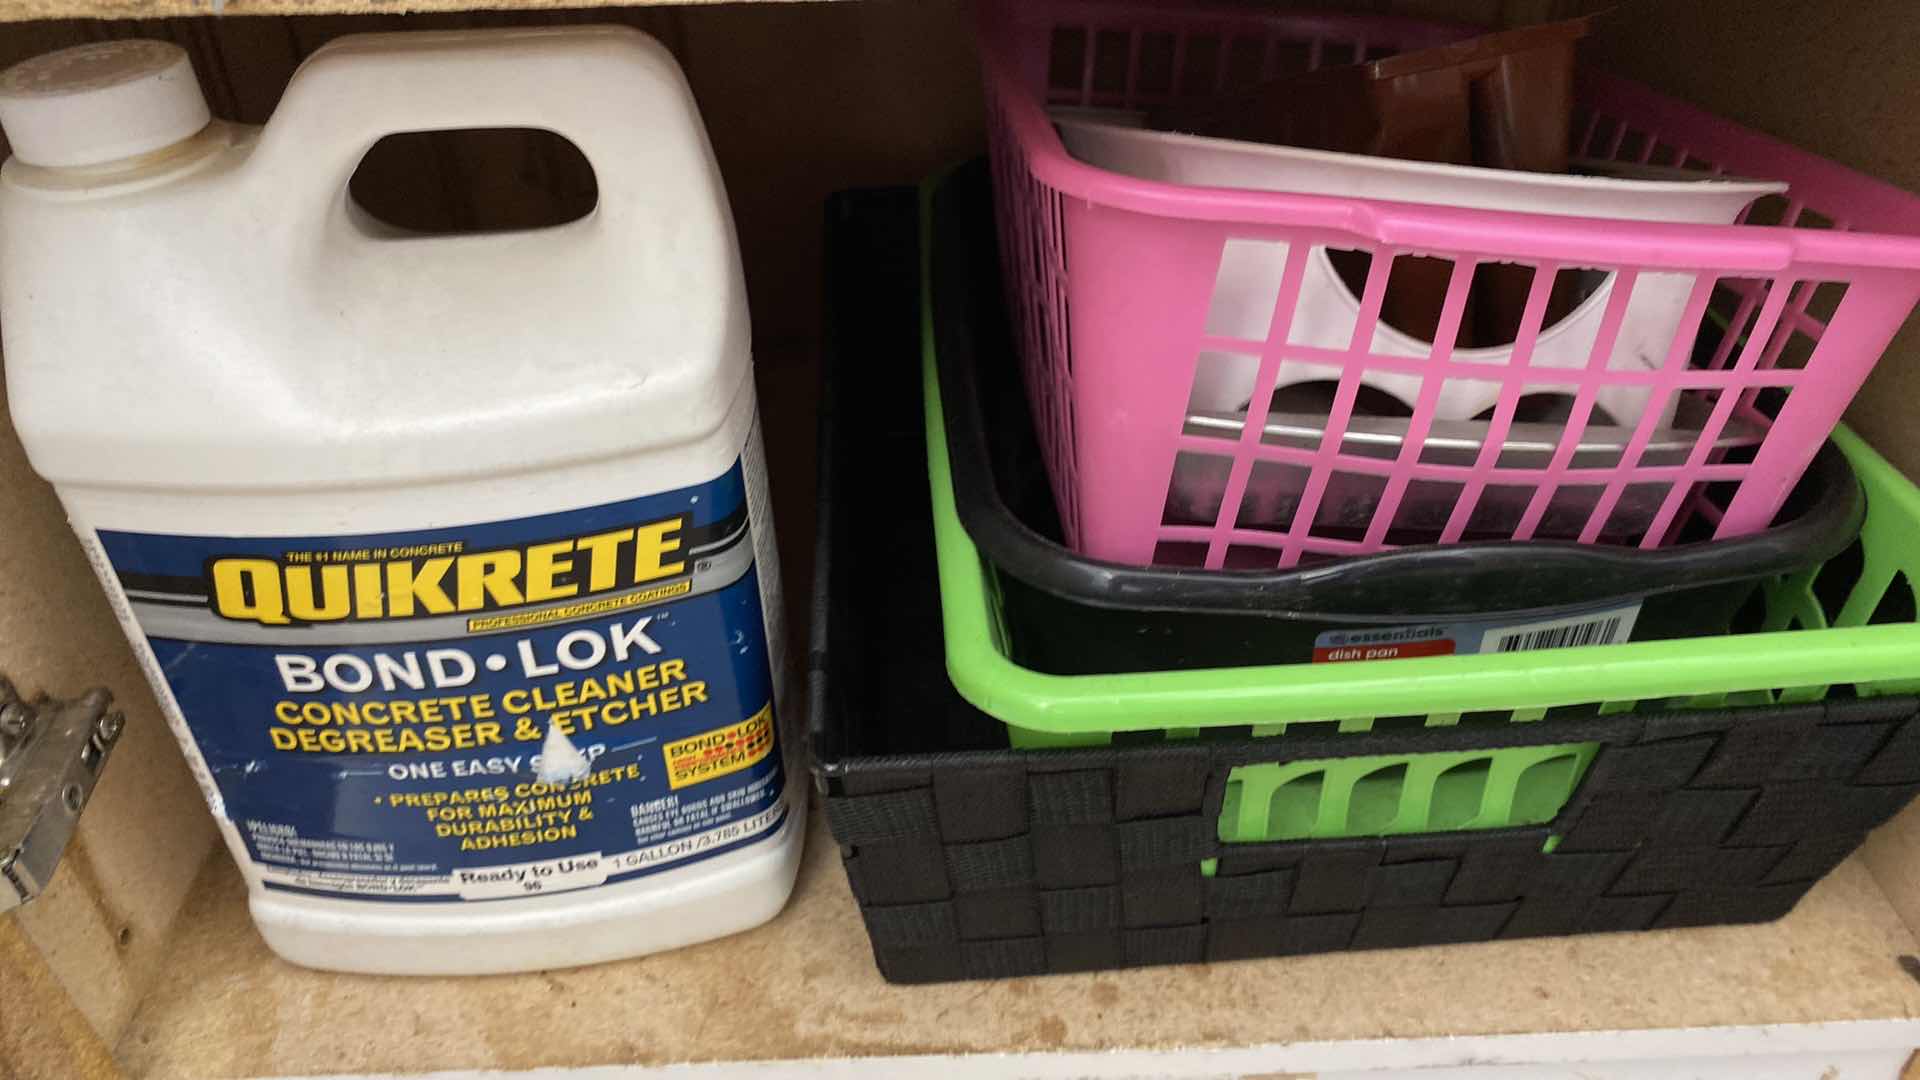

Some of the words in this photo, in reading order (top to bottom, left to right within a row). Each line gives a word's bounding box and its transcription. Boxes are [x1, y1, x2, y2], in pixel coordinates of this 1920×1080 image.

[287, 551, 312, 562] THE
[333, 549, 370, 561] NAME
[374, 547, 387, 559] IN
[390, 541, 464, 558] CONCRETE
[213, 517, 685, 625] QUIKRETE
[1351, 626, 1444, 643] essentials
[1328, 647, 1361, 661] dish
[1365, 646, 1398, 661] pan
[275, 694, 496, 726] CONCRETE
[502, 658, 688, 714] CLEANER
[269, 721, 504, 753] DEGREASER
[514, 716, 542, 741] &
[549, 680, 709, 737] ETCHER
[388, 761, 448, 781] ONE
[452, 755, 523, 778] EASY
[675, 751, 746, 781] SYSTEM
[389, 784, 510, 808] PREPARES
[427, 805, 473, 822] FOR
[479, 789, 593, 818] MAXIMUM
[435, 808, 572, 838] DURABILITY
[578, 806, 594, 821] &
[460, 824, 577, 851] ADHESION
[613, 857, 621, 869] 1
[626, 839, 692, 867] GALLON
[460, 867, 527, 885] Ready
[532, 865, 553, 877] to
[558, 858, 599, 874] Use
